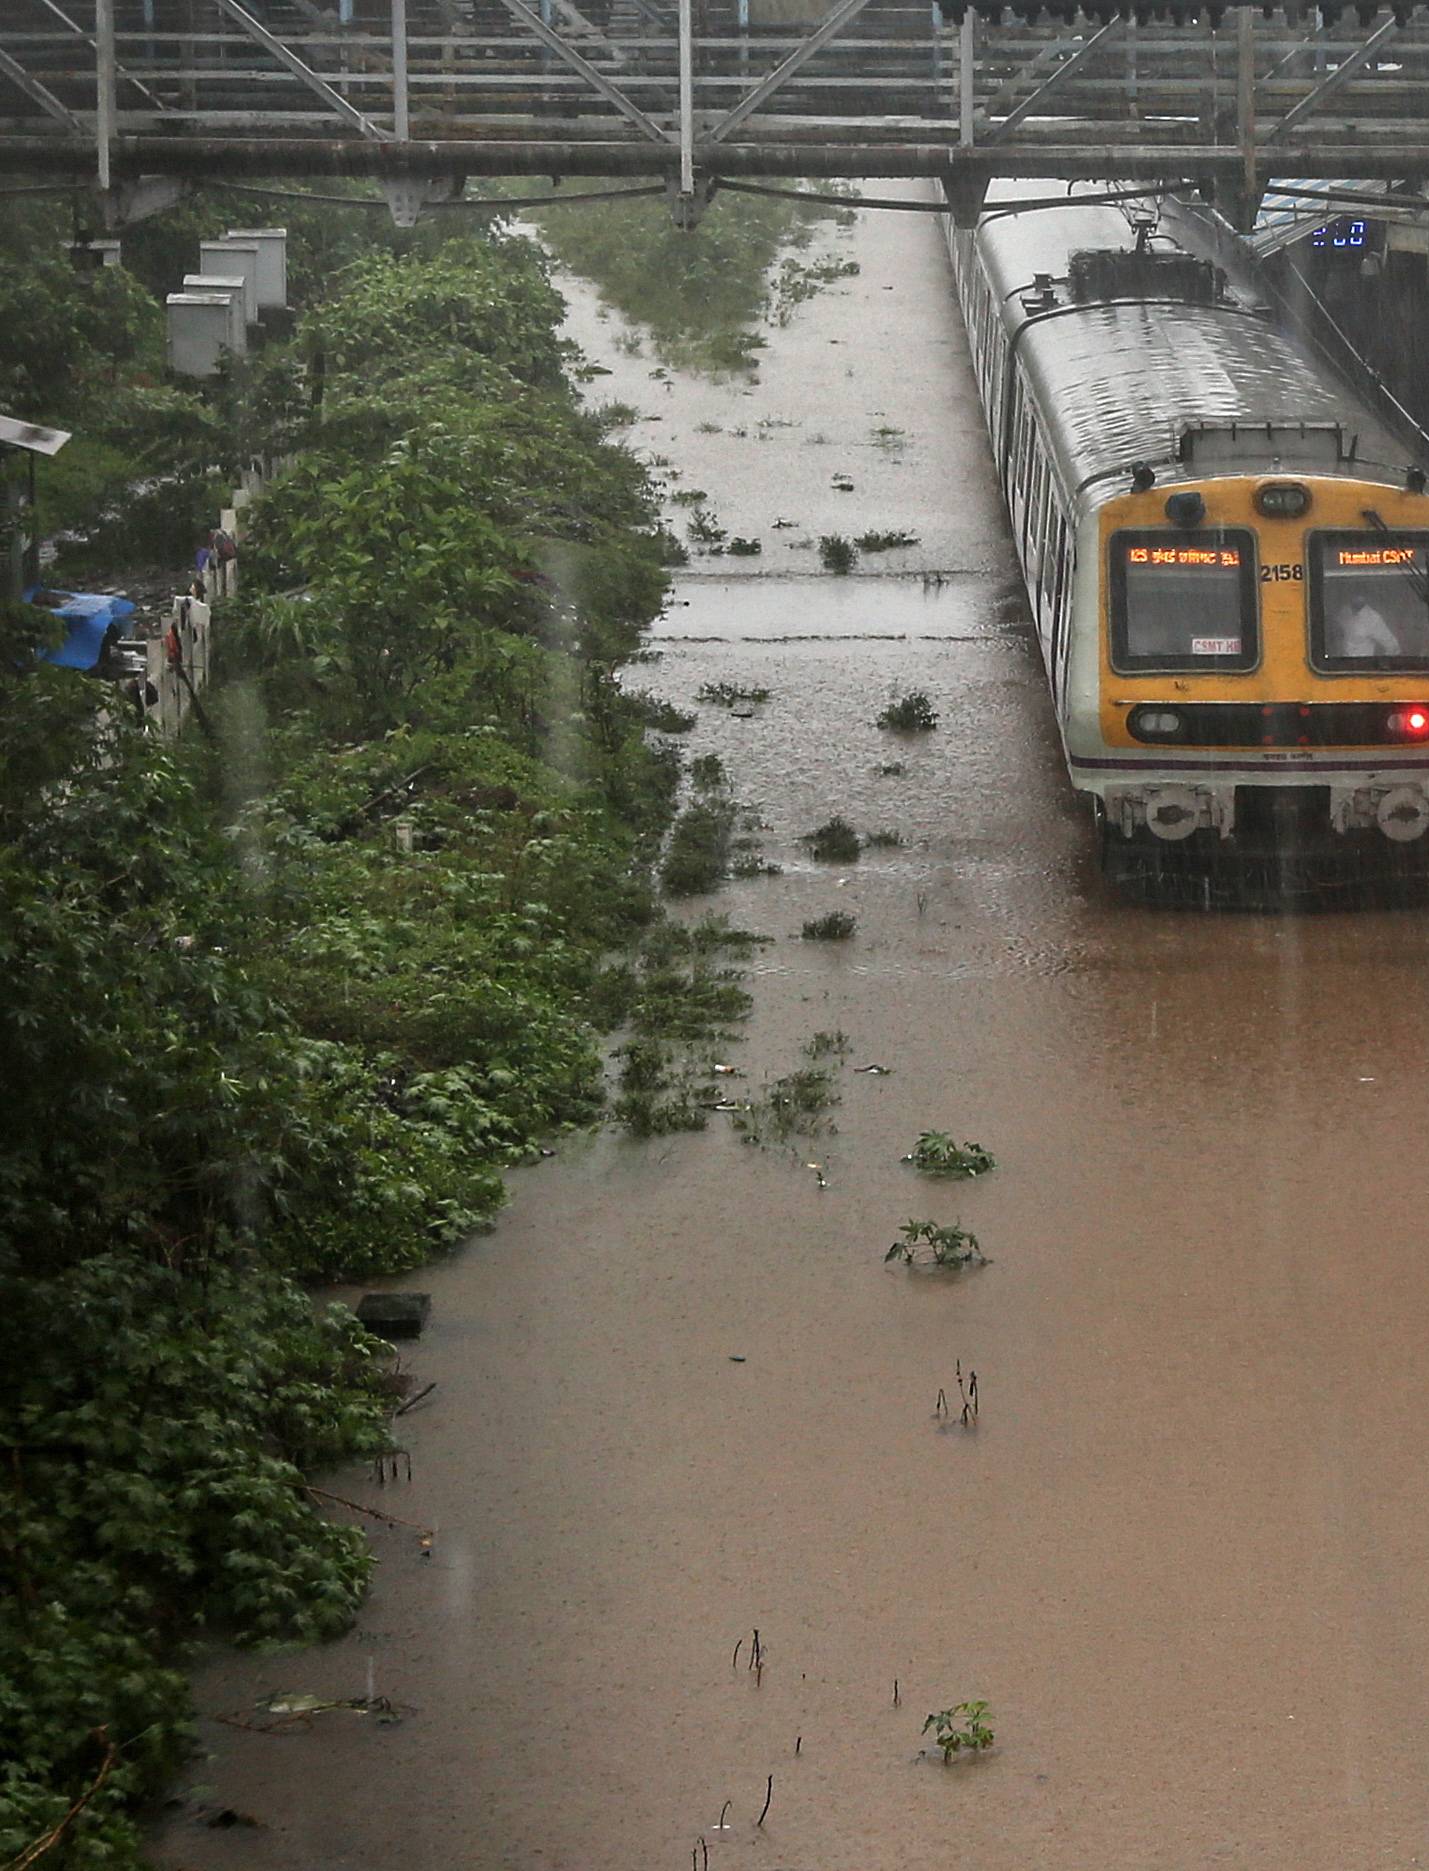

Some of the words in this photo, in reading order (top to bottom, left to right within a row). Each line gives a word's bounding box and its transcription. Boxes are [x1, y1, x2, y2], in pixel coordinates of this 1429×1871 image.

[1339, 552, 1381, 565] Mumbai
[1260, 564, 1303, 582] 2158
[1194, 640, 1222, 654] CSMT
